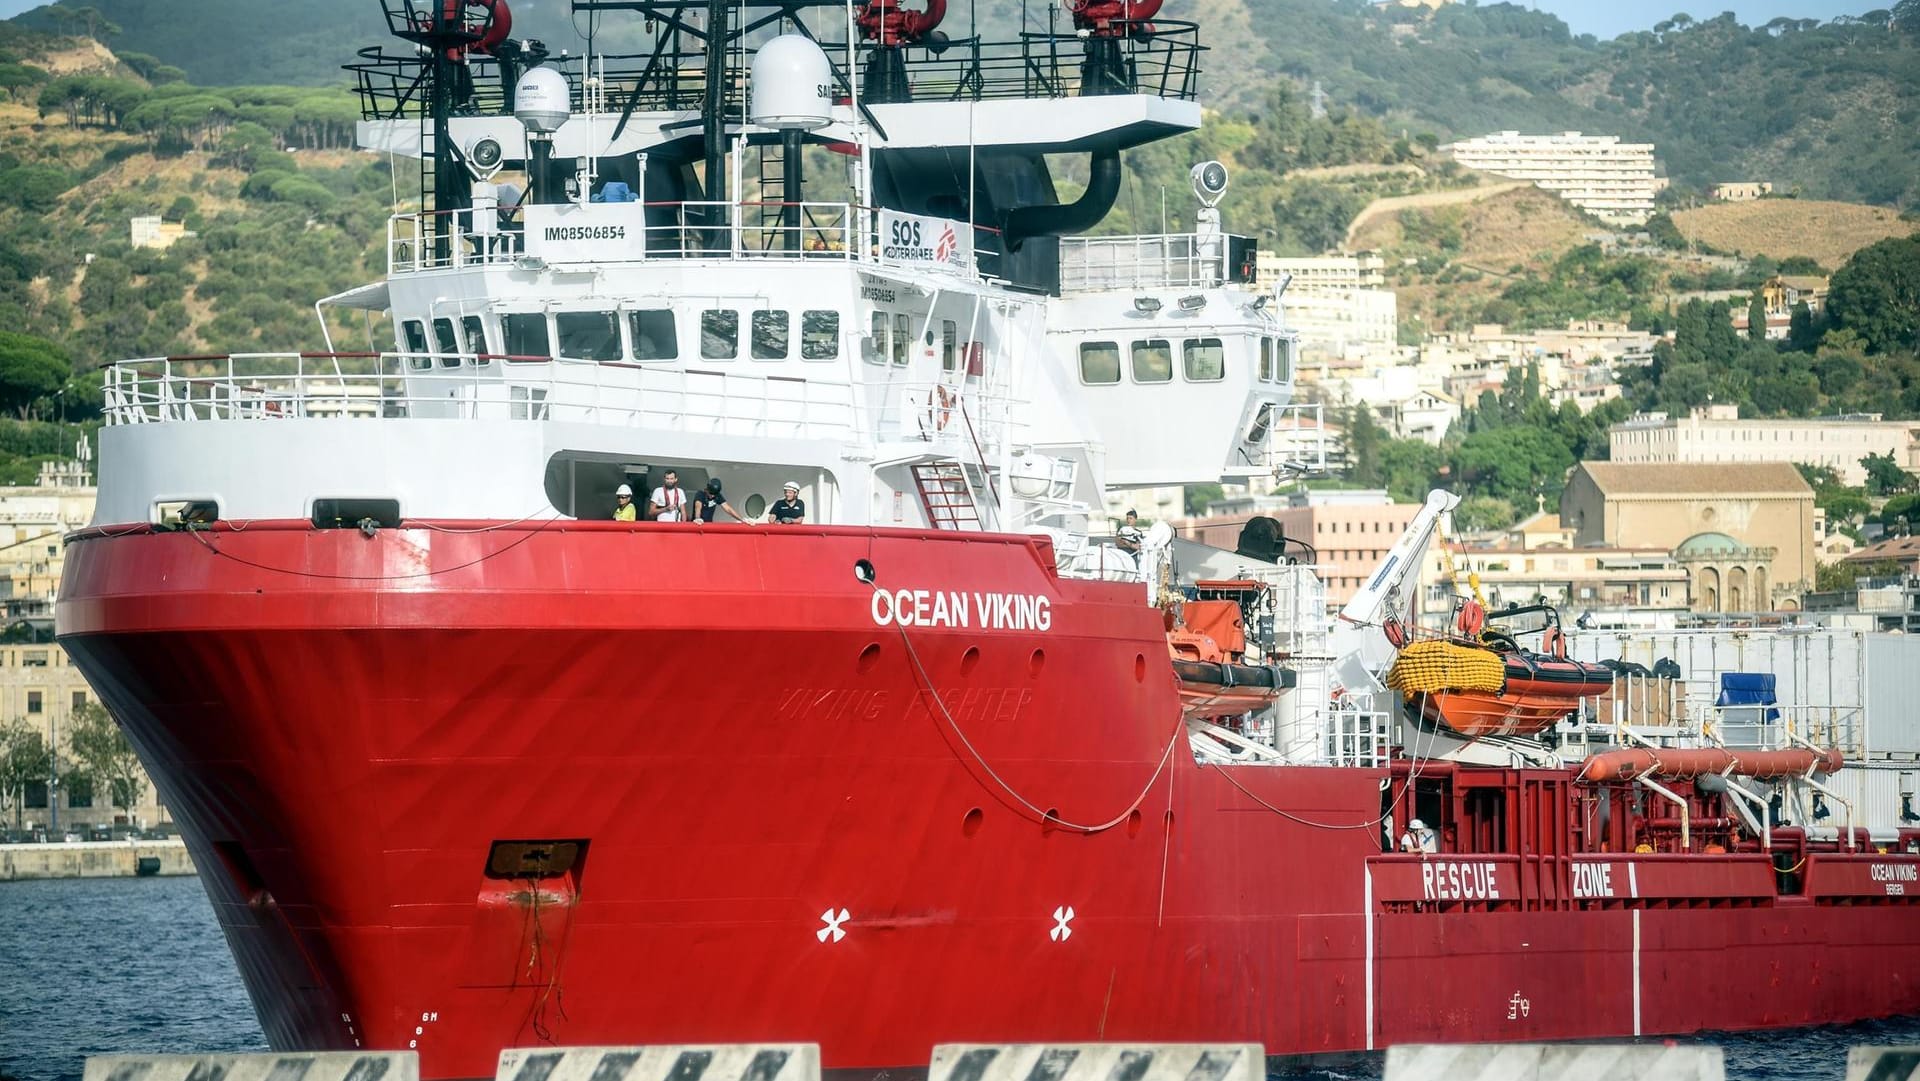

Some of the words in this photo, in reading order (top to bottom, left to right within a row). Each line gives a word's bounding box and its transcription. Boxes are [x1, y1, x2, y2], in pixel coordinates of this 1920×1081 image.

[892, 220, 921, 247] SOS
[871, 589, 969, 627] OCEAN
[974, 592, 1051, 631] VIKING
[1422, 862, 1500, 899] RESCUE
[1571, 862, 1614, 898] ZONE
[1871, 864, 1895, 881] OCEAN
[1894, 864, 1918, 881] VIKING
[409, 1039, 417, 1049] 6
